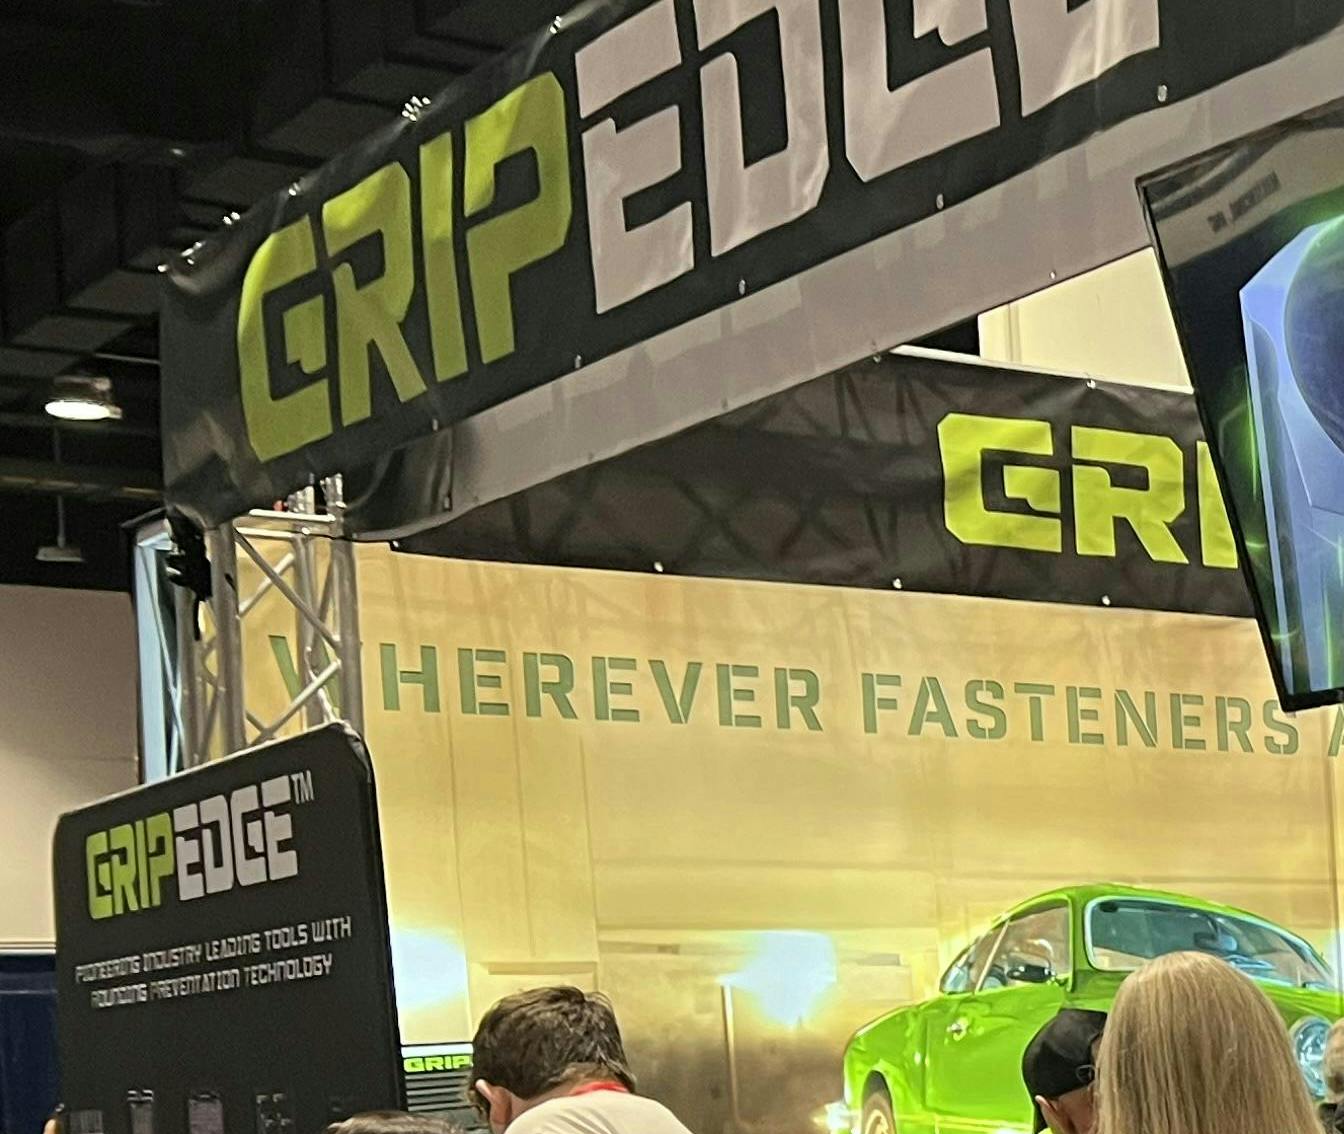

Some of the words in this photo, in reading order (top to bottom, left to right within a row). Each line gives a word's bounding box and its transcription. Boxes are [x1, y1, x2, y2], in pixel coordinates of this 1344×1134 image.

[863, 673, 1299, 757] FASTENERS
[205, 933, 262, 962] LEADING
[264, 923, 309, 951] TOOLS
[311, 915, 353, 944] WITH
[243, 952, 334, 987] TECHNOLOGY
